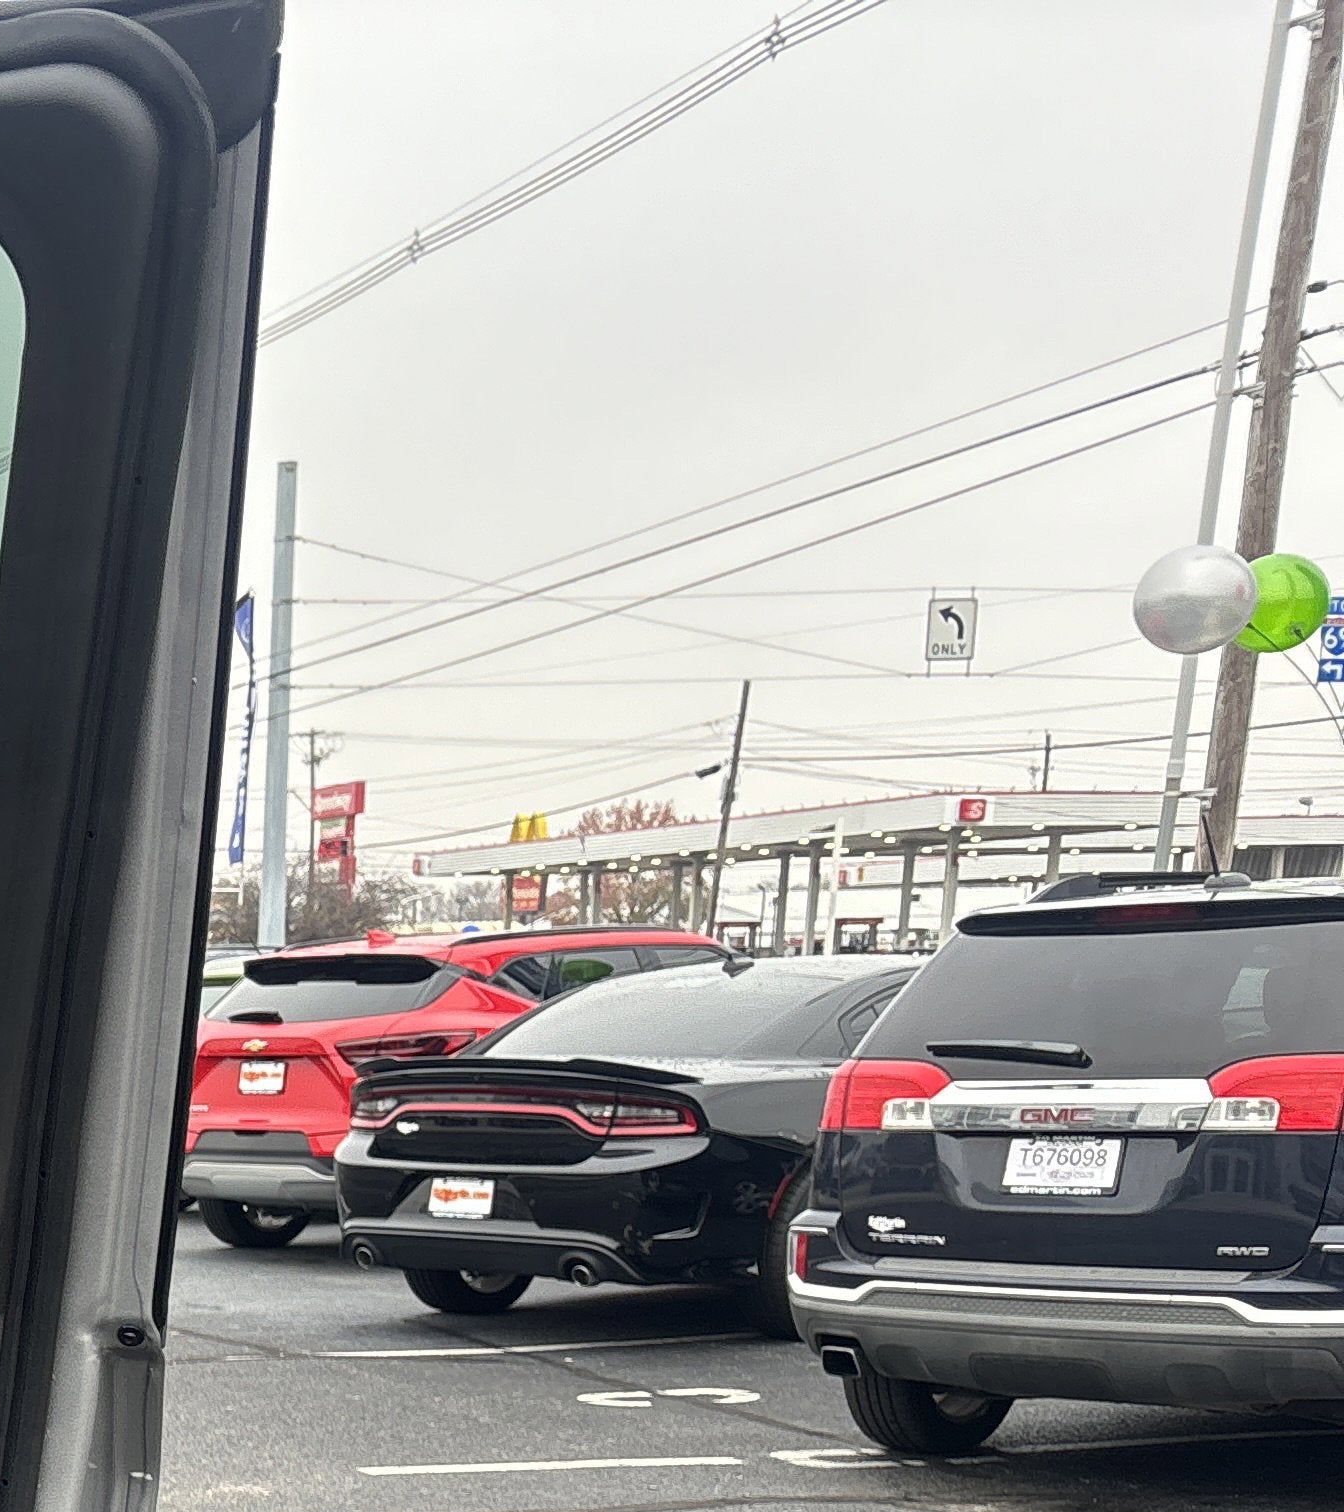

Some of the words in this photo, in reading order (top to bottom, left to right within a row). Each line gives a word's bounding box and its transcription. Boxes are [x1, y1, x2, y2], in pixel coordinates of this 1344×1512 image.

[932, 643, 967, 656] ONLY
[1020, 1107, 1096, 1124] GMC
[1018, 1147, 1108, 1168] T676098
